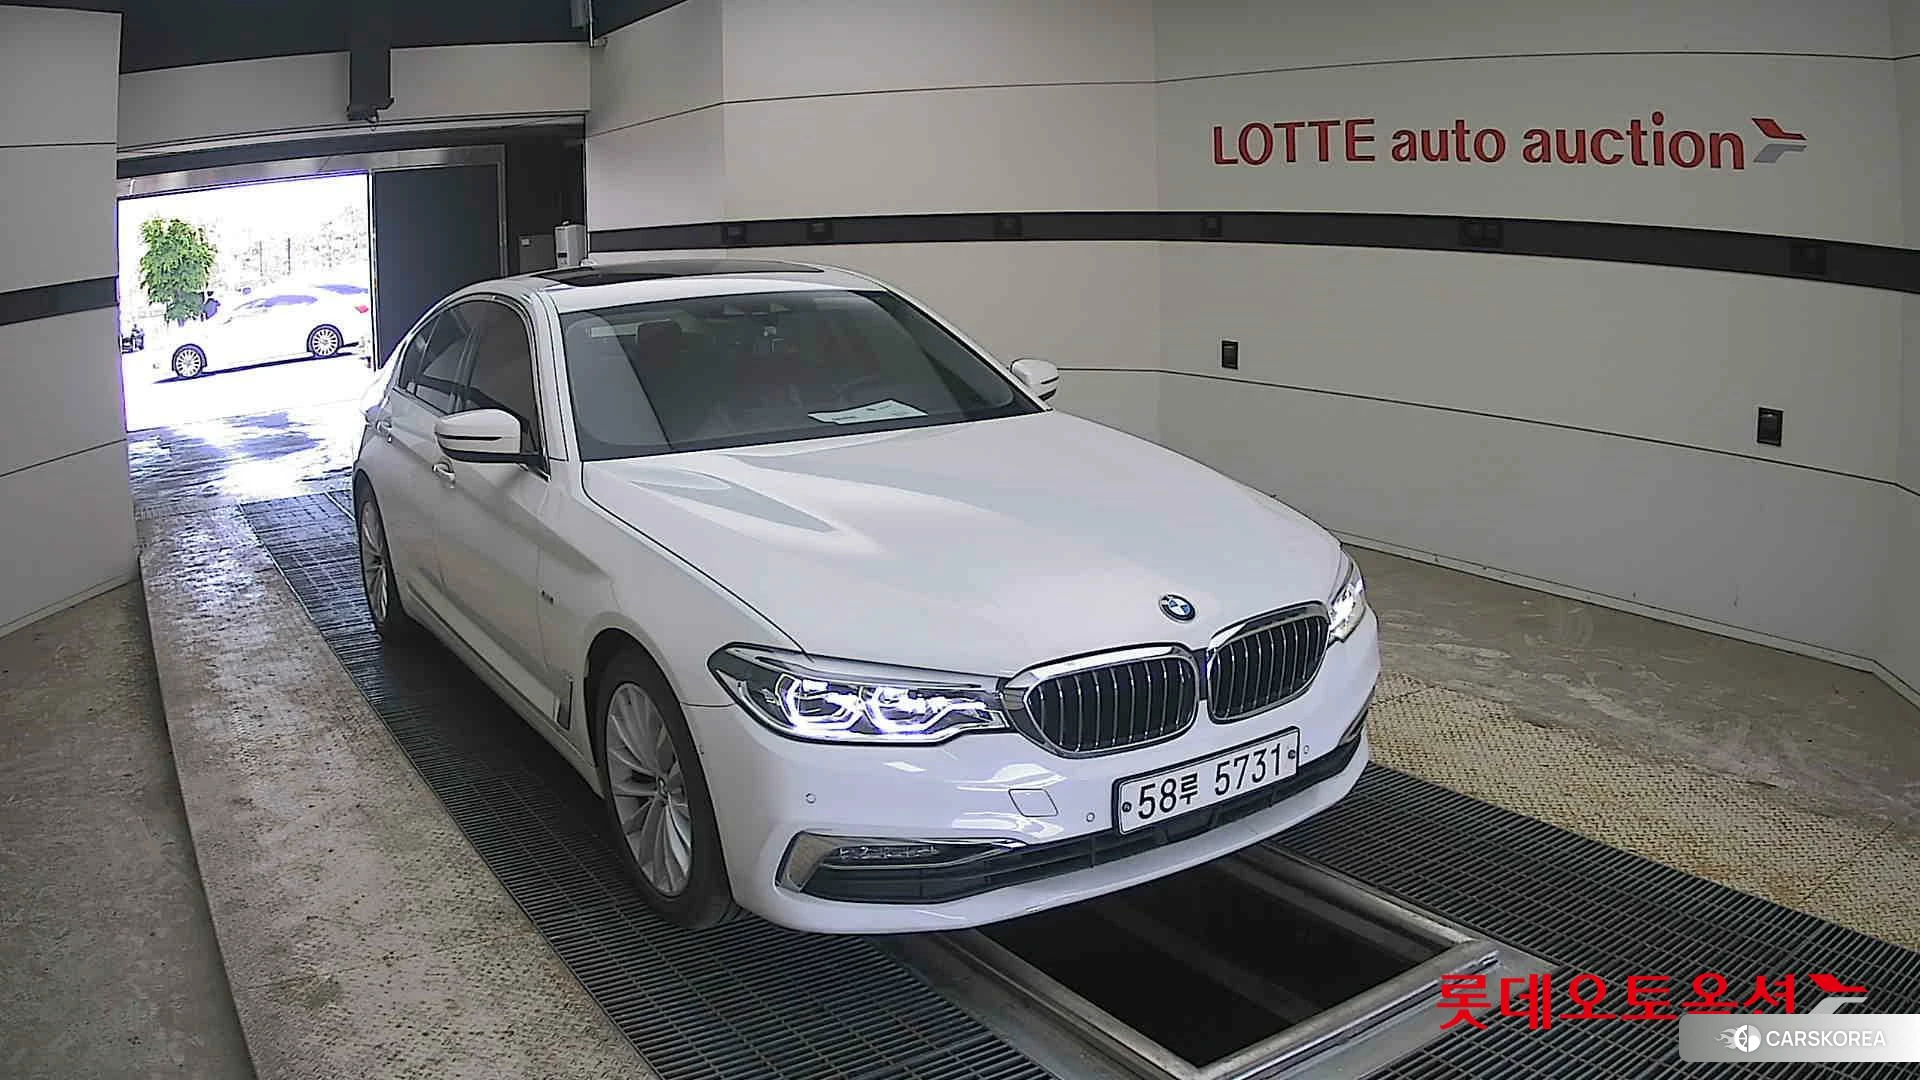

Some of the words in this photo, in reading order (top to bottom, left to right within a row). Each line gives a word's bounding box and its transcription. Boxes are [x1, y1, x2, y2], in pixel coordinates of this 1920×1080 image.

[1213, 118, 1376, 166] LOTTE
[1391, 119, 1507, 163] auto
[1523, 111, 1745, 170] auction
[1137, 772, 1199, 820] 58루
[1214, 743, 1282, 796] 5731
